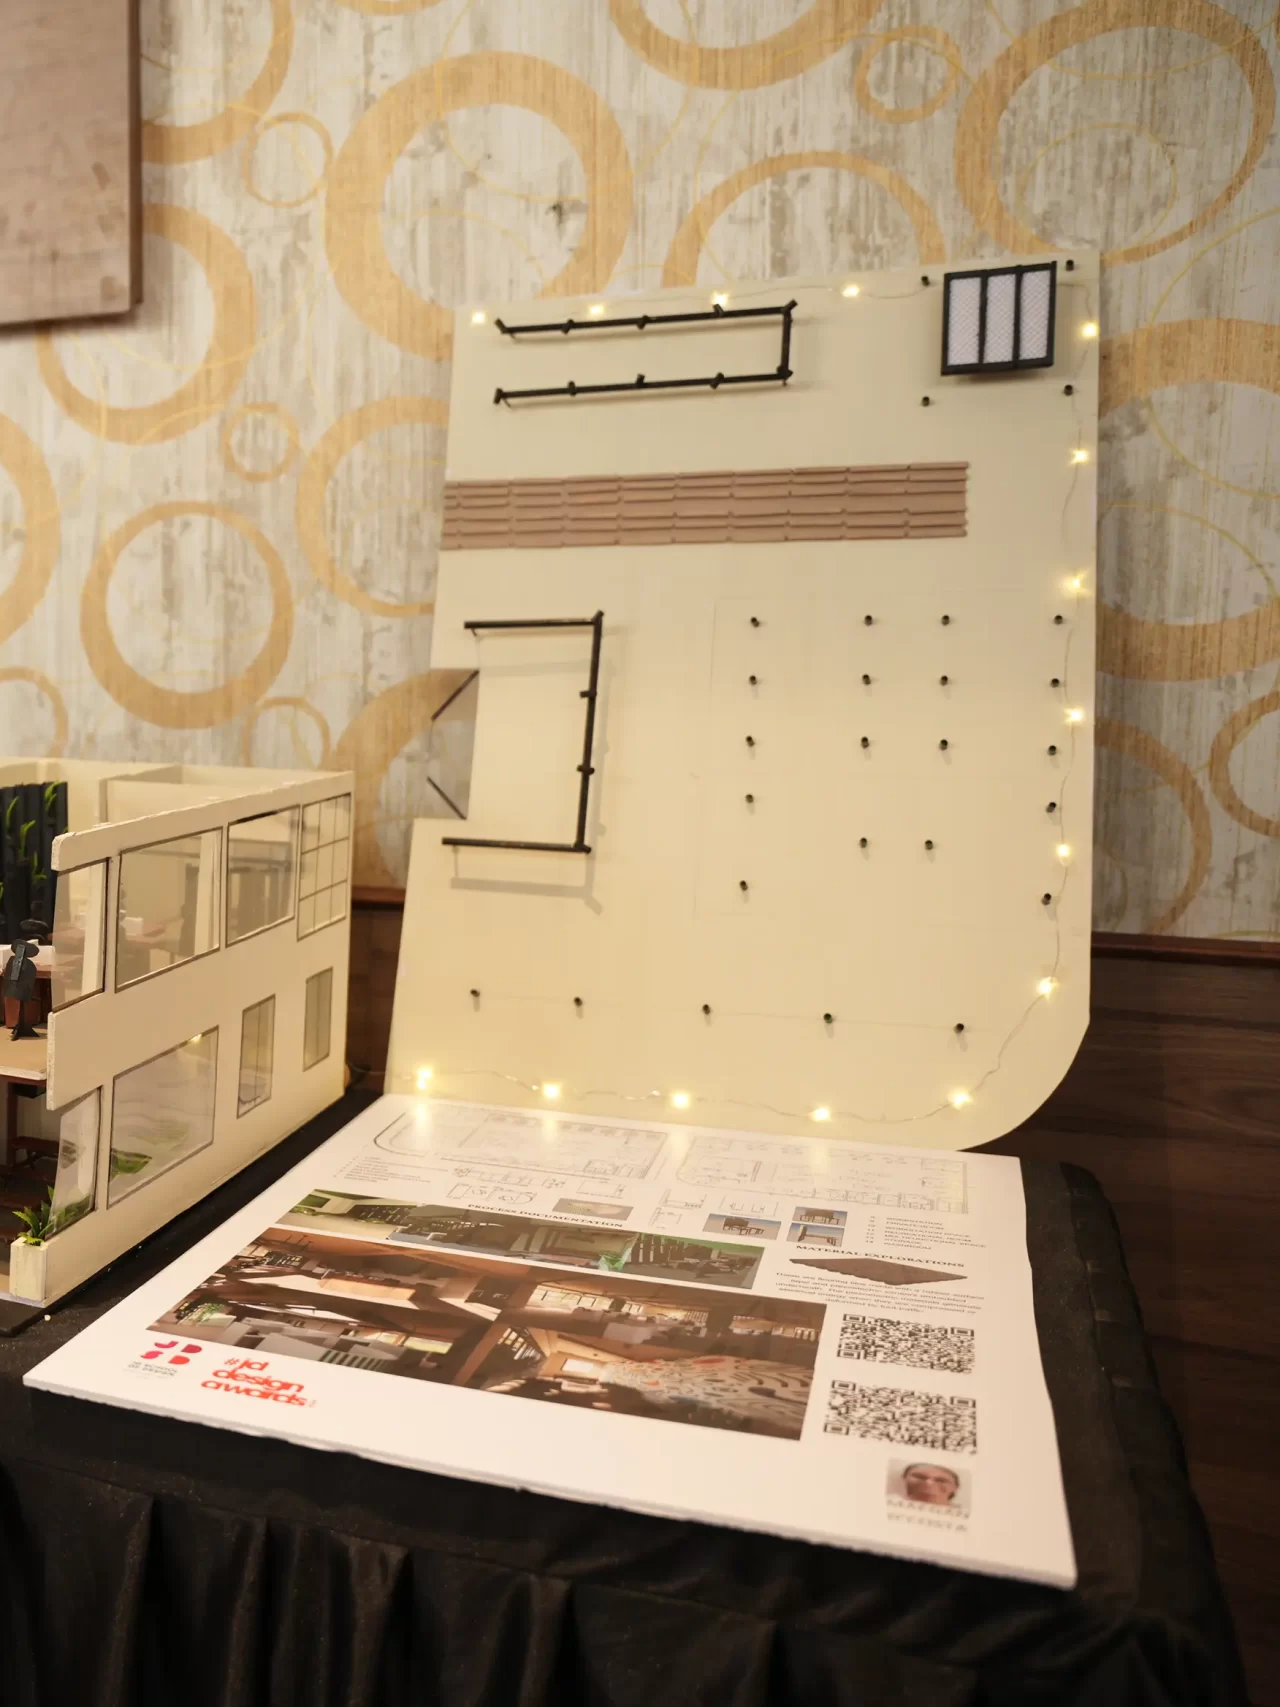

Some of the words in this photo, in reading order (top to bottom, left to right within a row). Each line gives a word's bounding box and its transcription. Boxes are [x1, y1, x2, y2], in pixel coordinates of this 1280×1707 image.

[468, 1203, 517, 1213] PROCESS
[520, 1211, 623, 1228] DOCUMENTATION
[796, 1244, 862, 1256] MATERIAL
[865, 1253, 965, 1267] EXPLORATIONS
[224, 1357, 269, 1371] #jd
[201, 1380, 307, 1406] awards
[212, 1368, 304, 1393] design
